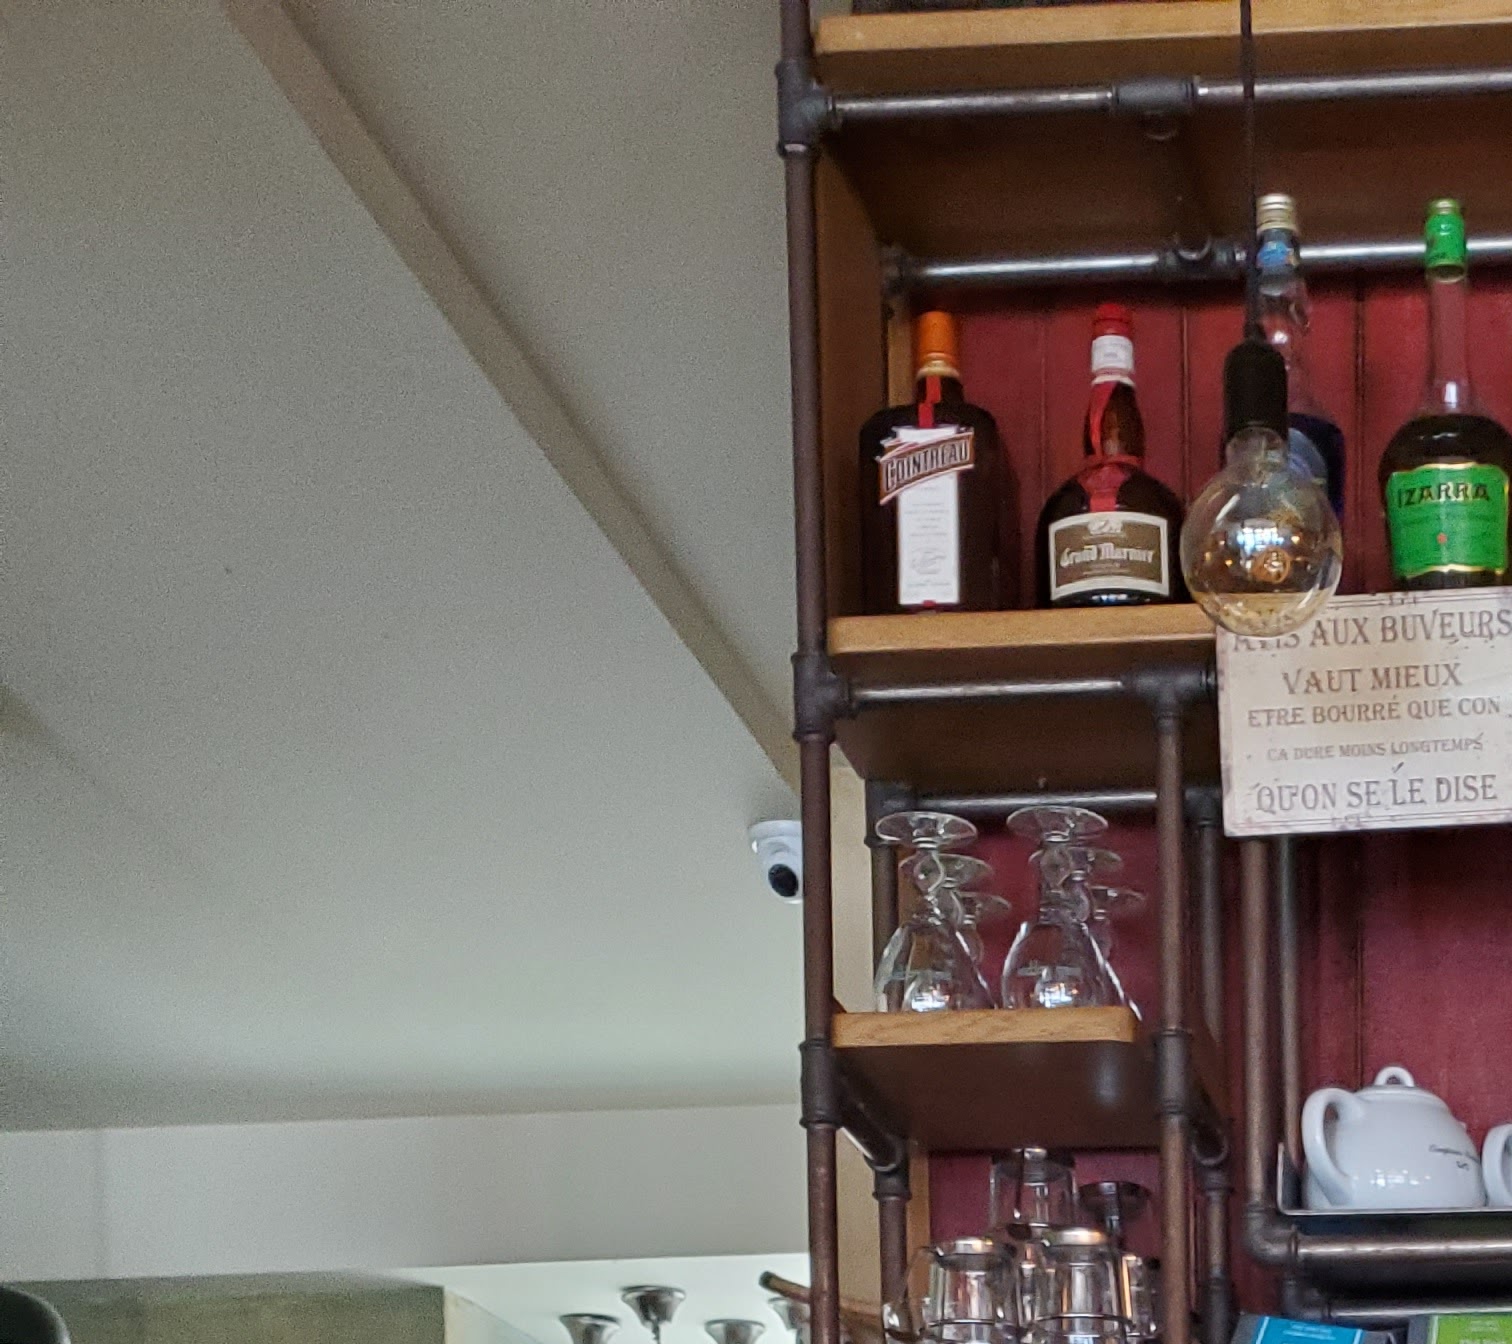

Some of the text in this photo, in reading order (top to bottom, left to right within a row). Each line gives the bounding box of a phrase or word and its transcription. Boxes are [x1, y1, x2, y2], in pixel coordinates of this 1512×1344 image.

[884, 433, 969, 492] COINTREAU
[1397, 480, 1490, 509] IZARRA
[1309, 617, 1371, 648] AUX
[1282, 662, 1462, 696] VAUT MIEUX
[1407, 698, 1451, 720] QUE
[1458, 696, 1501, 716] CON
[1339, 742, 1386, 758] MOINS
[1391, 737, 1484, 755] LONGTEMPS
[1347, 780, 1381, 808] SE
[1390, 777, 1426, 805] LE
[1435, 774, 1499, 803] DISE
